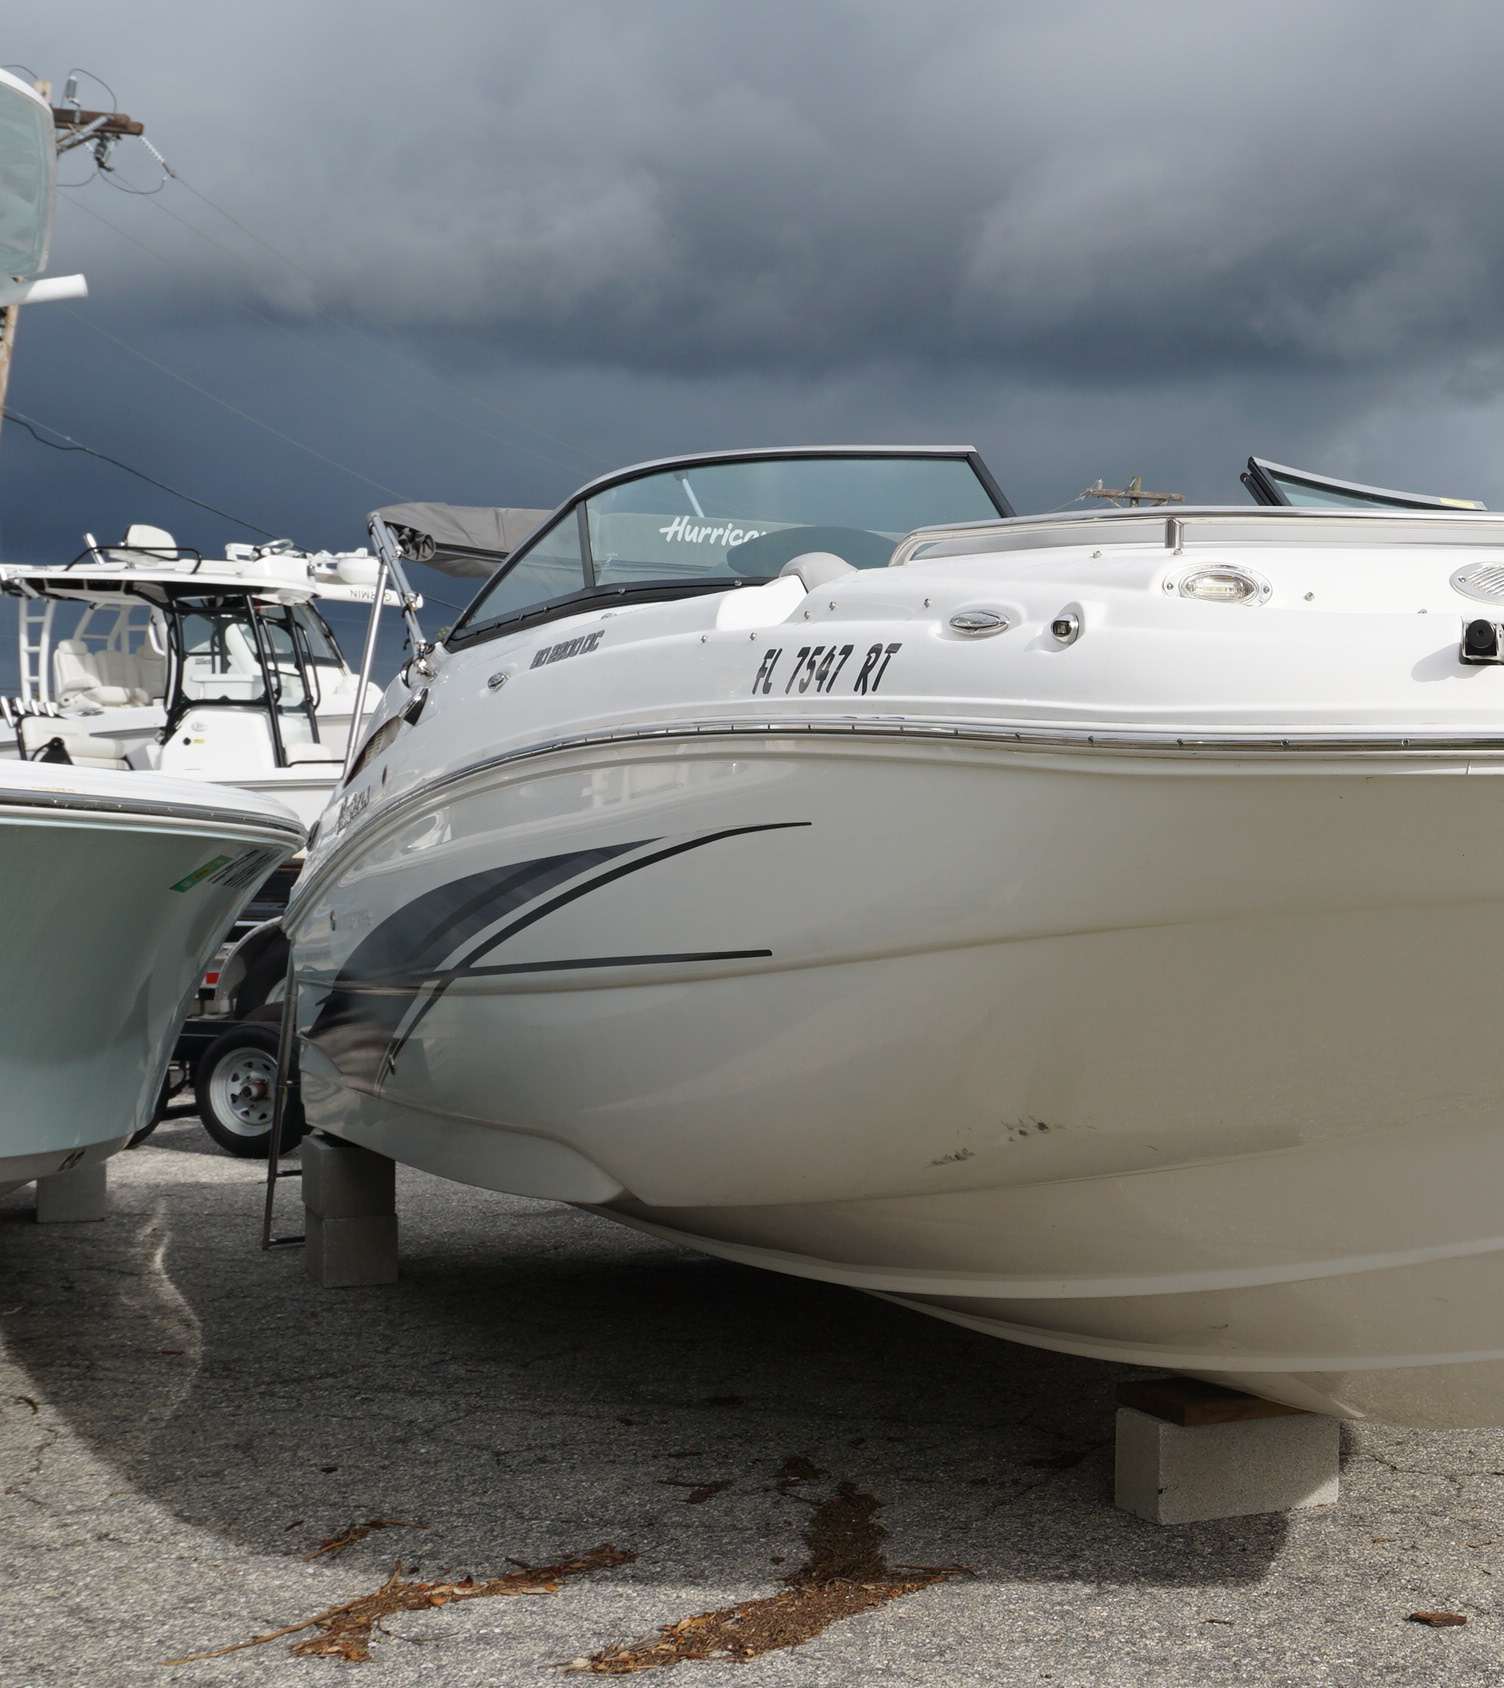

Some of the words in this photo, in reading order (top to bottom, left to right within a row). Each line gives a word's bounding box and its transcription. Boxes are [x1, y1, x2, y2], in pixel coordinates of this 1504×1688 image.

[659, 515, 767, 546] Hurrica
[752, 648, 783, 695] FL
[785, 644, 854, 694] 7547
[853, 643, 903, 696] RT
